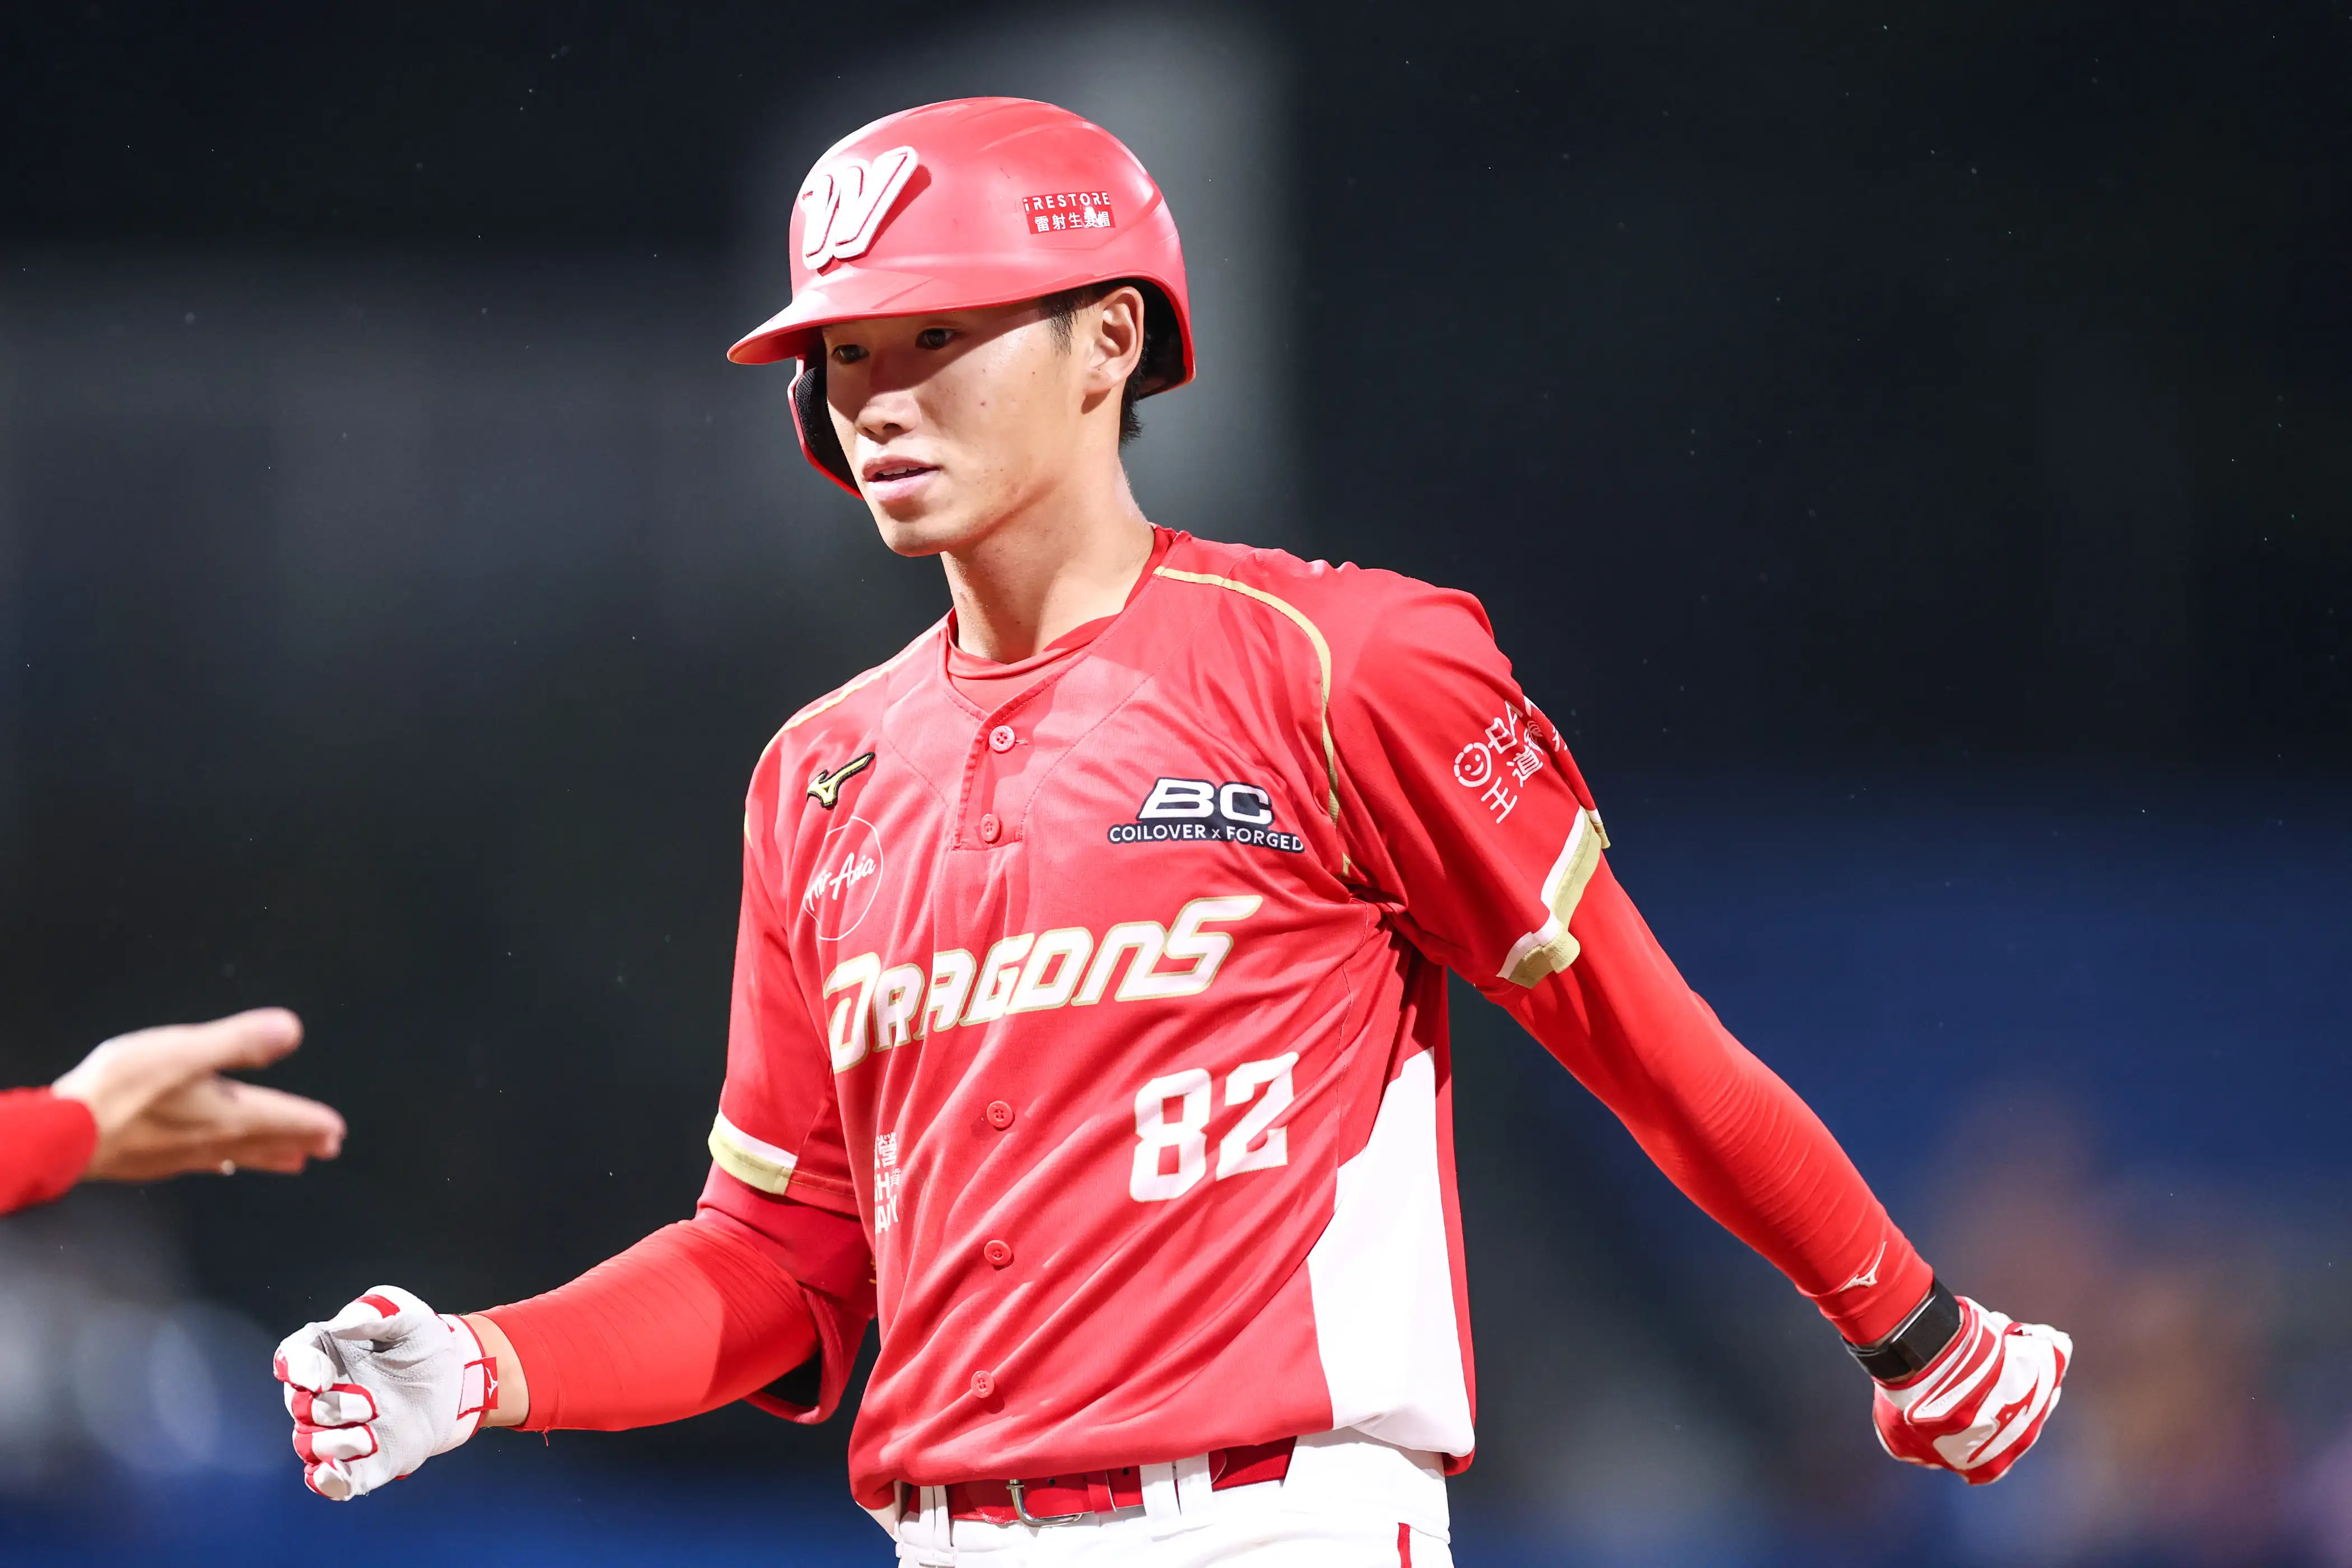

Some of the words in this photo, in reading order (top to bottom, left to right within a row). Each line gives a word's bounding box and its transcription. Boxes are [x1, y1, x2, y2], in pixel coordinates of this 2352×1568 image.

[797, 146, 919, 270] W
[1023, 192, 1110, 212] iRESTORE
[1138, 777, 1273, 825] BC
[1109, 824, 1206, 842] COILOVER
[1226, 825, 1304, 851] FORGED
[1129, 1051, 1300, 1203] 82
